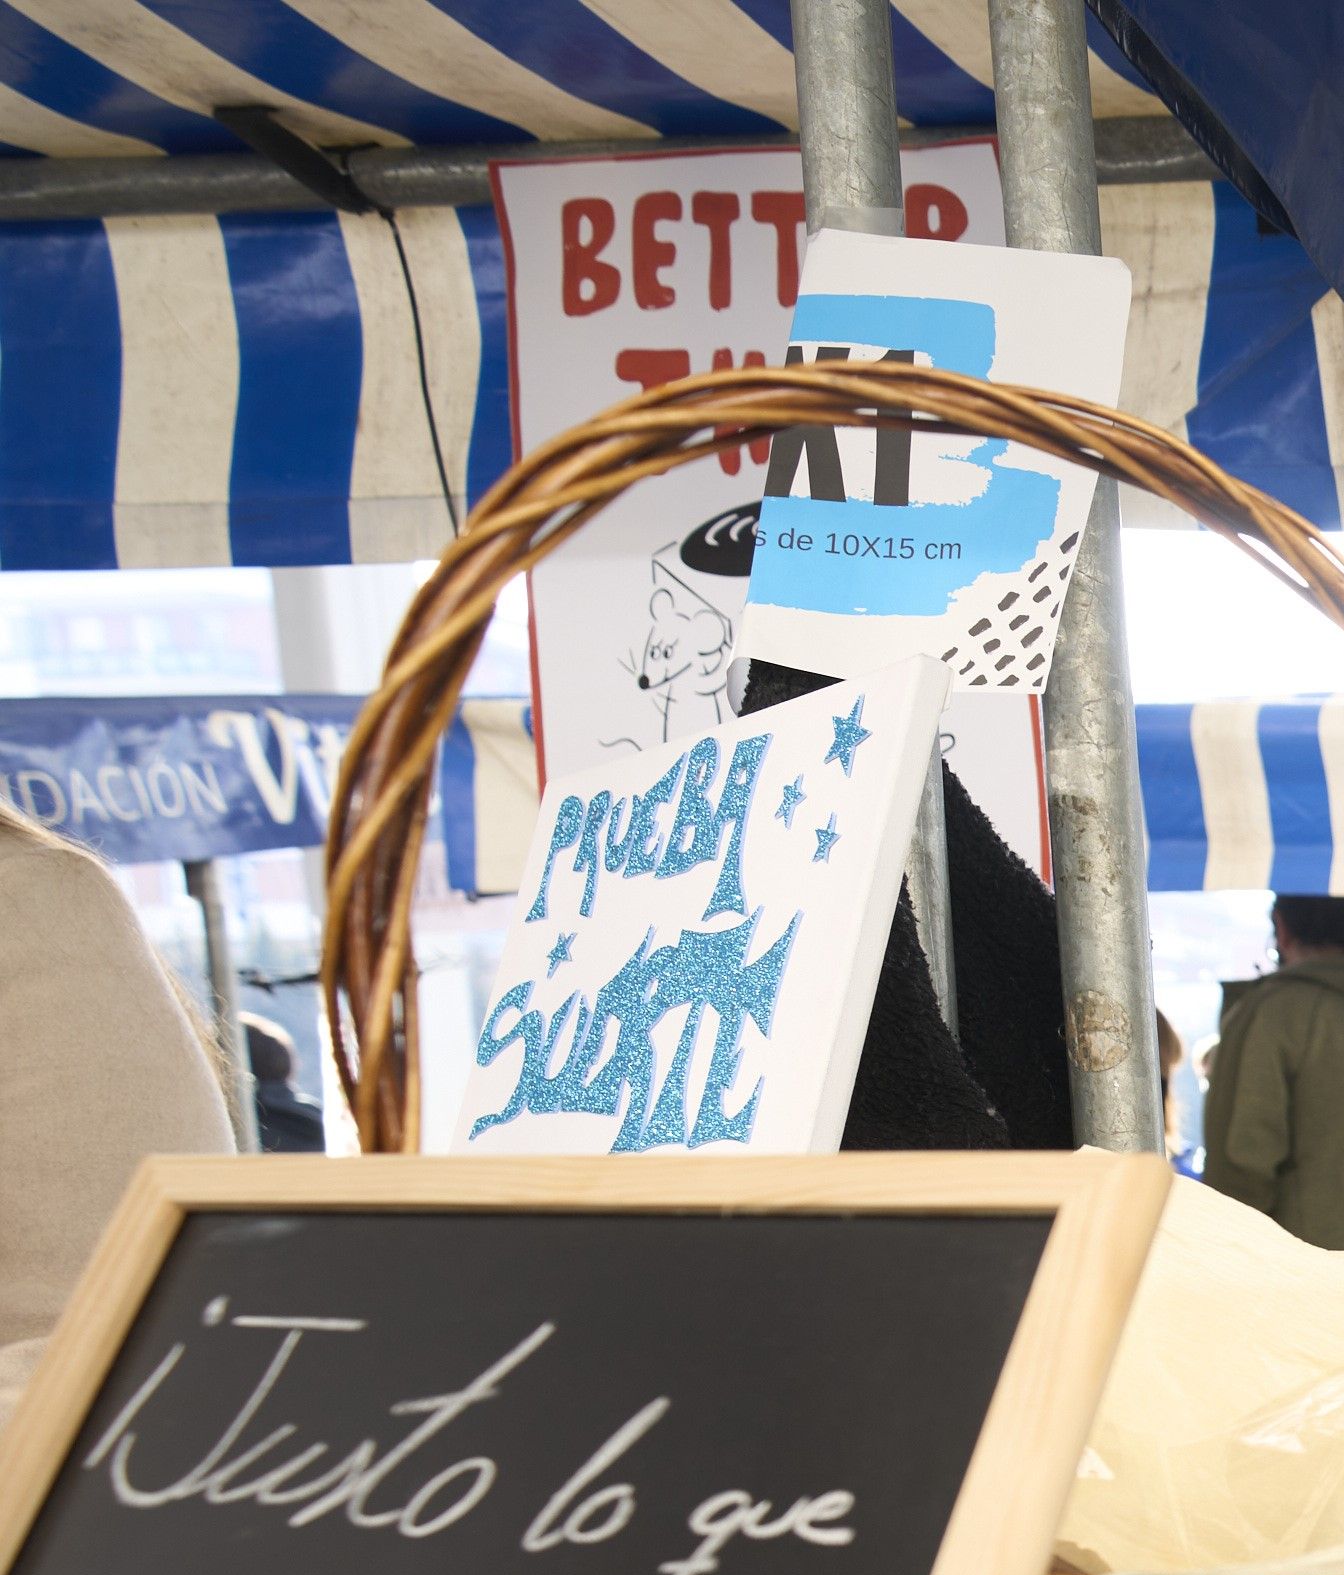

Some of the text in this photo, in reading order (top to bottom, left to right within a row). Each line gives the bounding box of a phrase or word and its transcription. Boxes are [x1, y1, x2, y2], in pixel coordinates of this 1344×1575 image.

[562, 182, 970, 317] BETT
[777, 528, 813, 551] de
[825, 532, 915, 560] 10X15
[924, 540, 962, 560] cm
[0, 757, 228, 826] DACIÓN
[524, 732, 774, 922] PRUEBA
[468, 904, 805, 1155] SUERTE
[522, 1397, 670, 1551] lo
